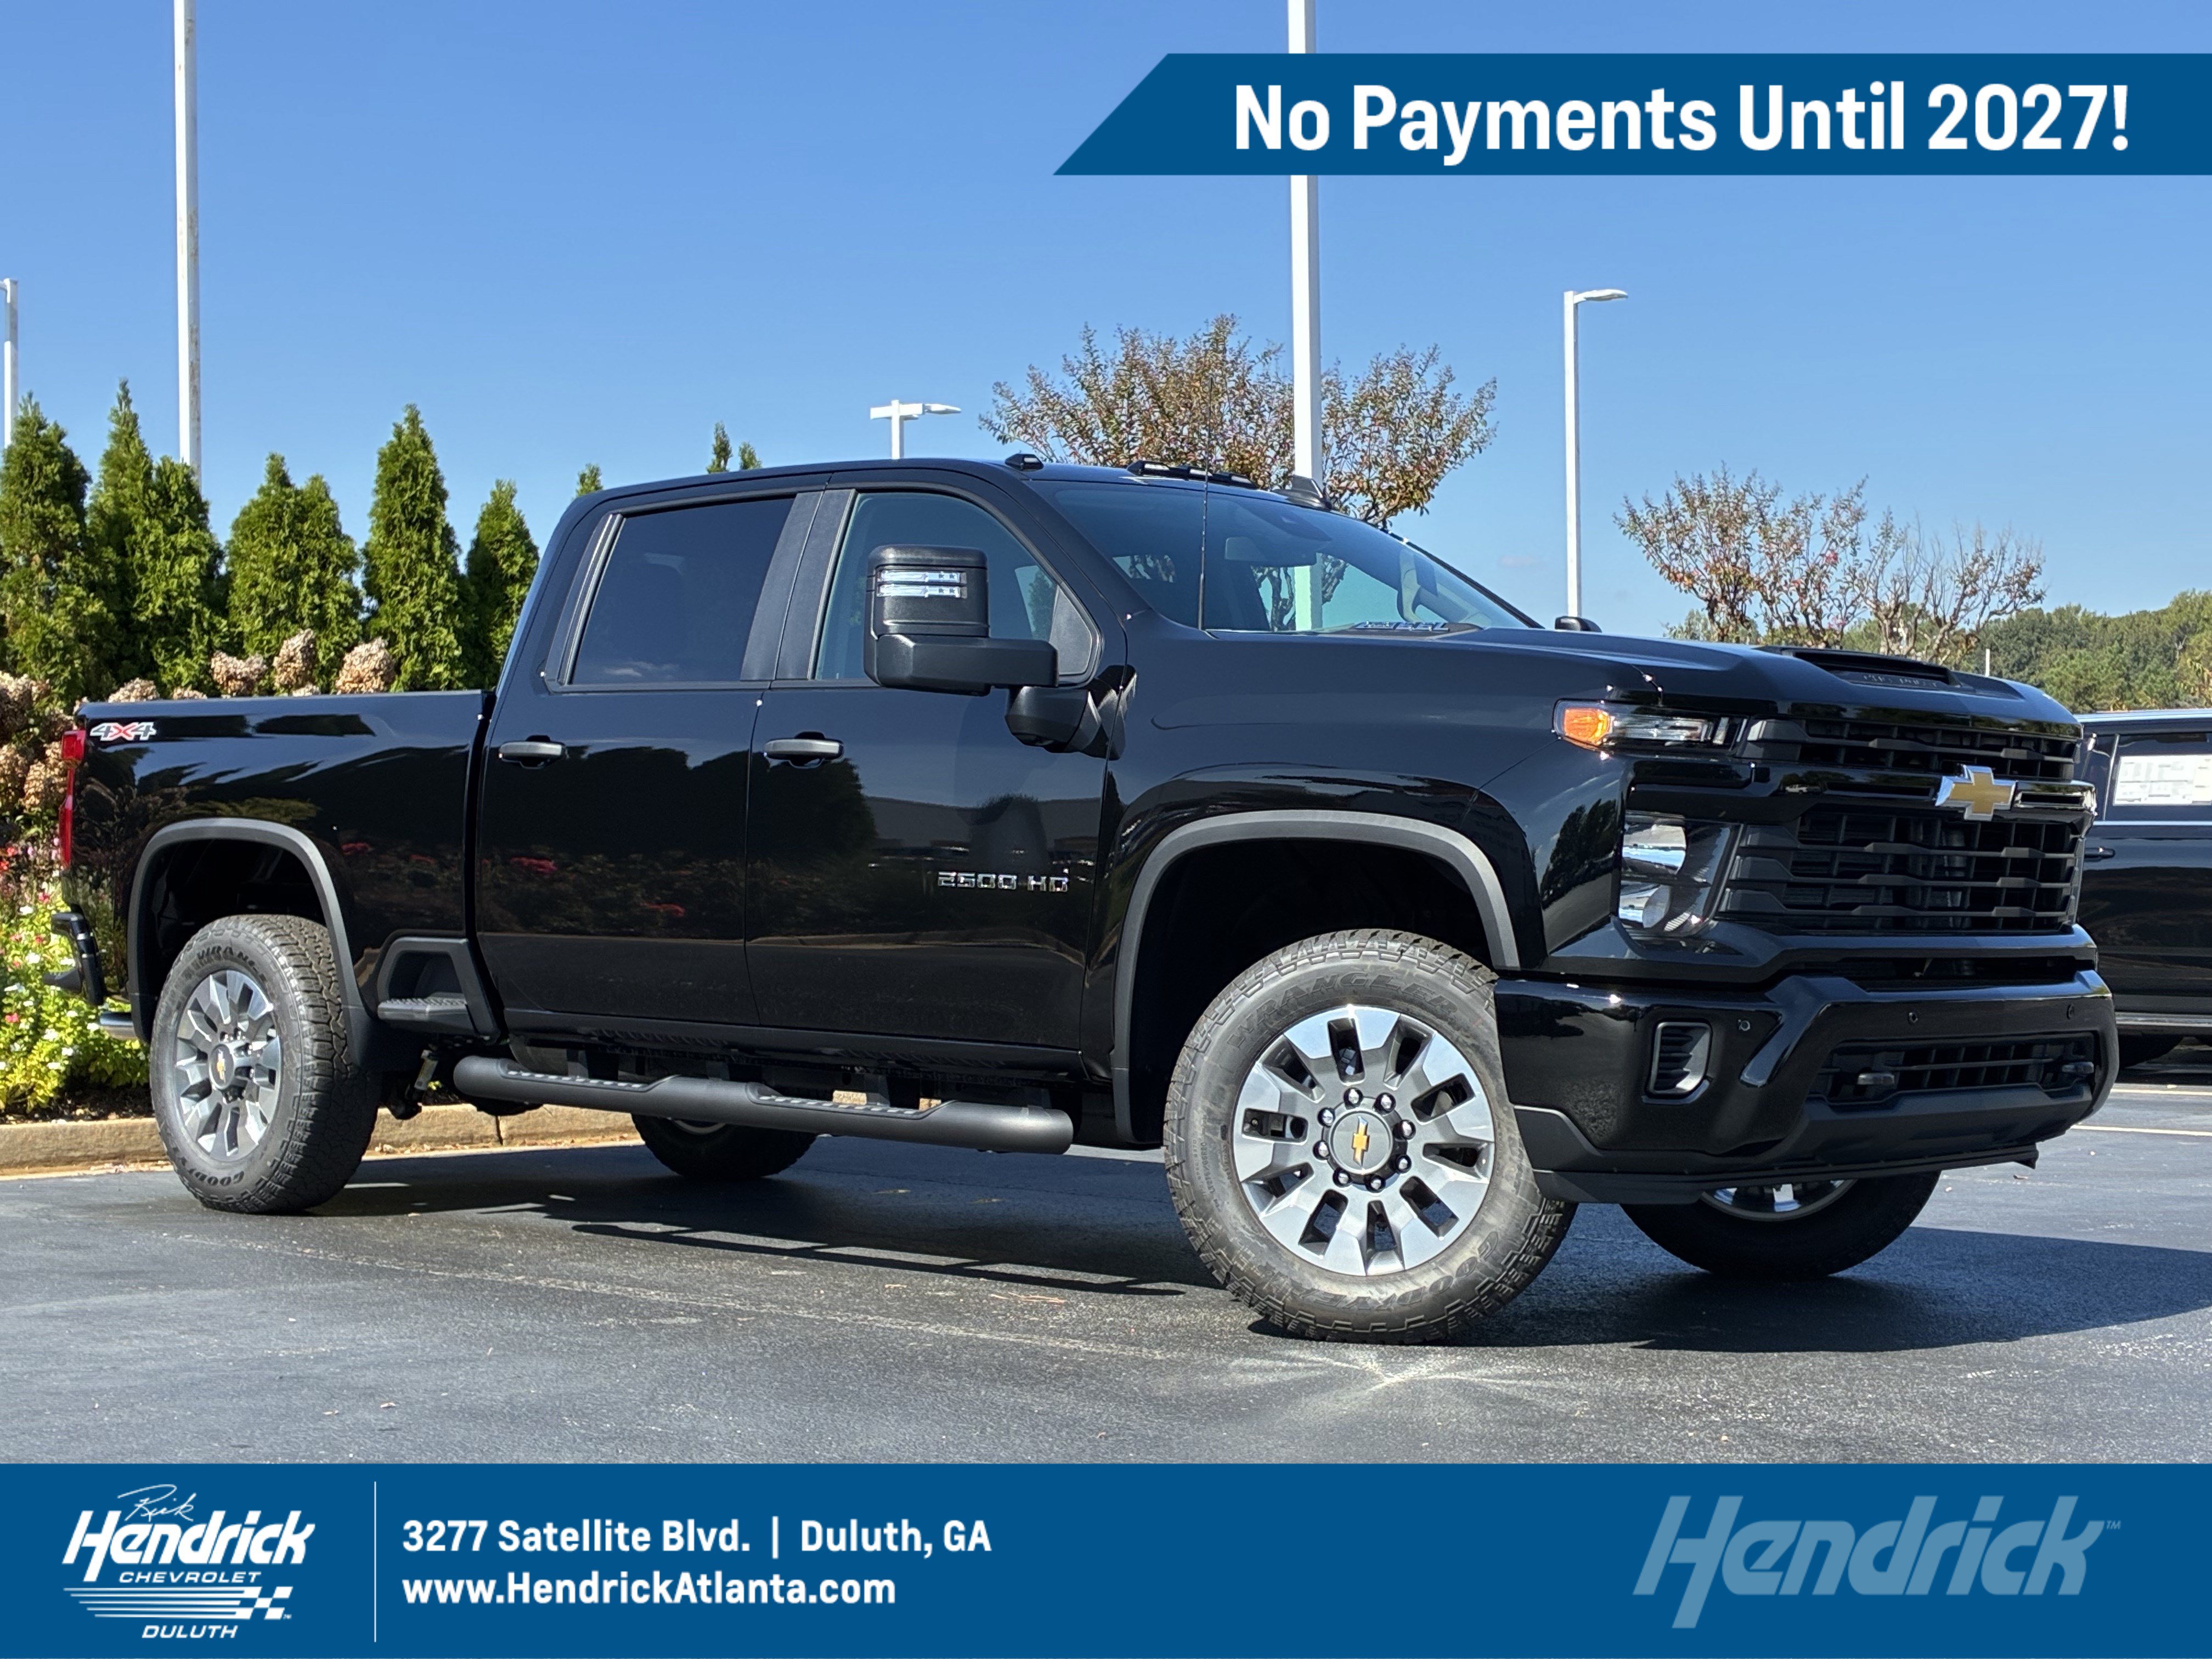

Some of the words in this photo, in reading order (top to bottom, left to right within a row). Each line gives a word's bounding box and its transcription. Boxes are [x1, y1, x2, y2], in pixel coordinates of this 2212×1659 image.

[938, 871, 1018, 890] 2500
[1028, 875, 1068, 893] HD
[1227, 972, 1458, 1048] WRANGLER
